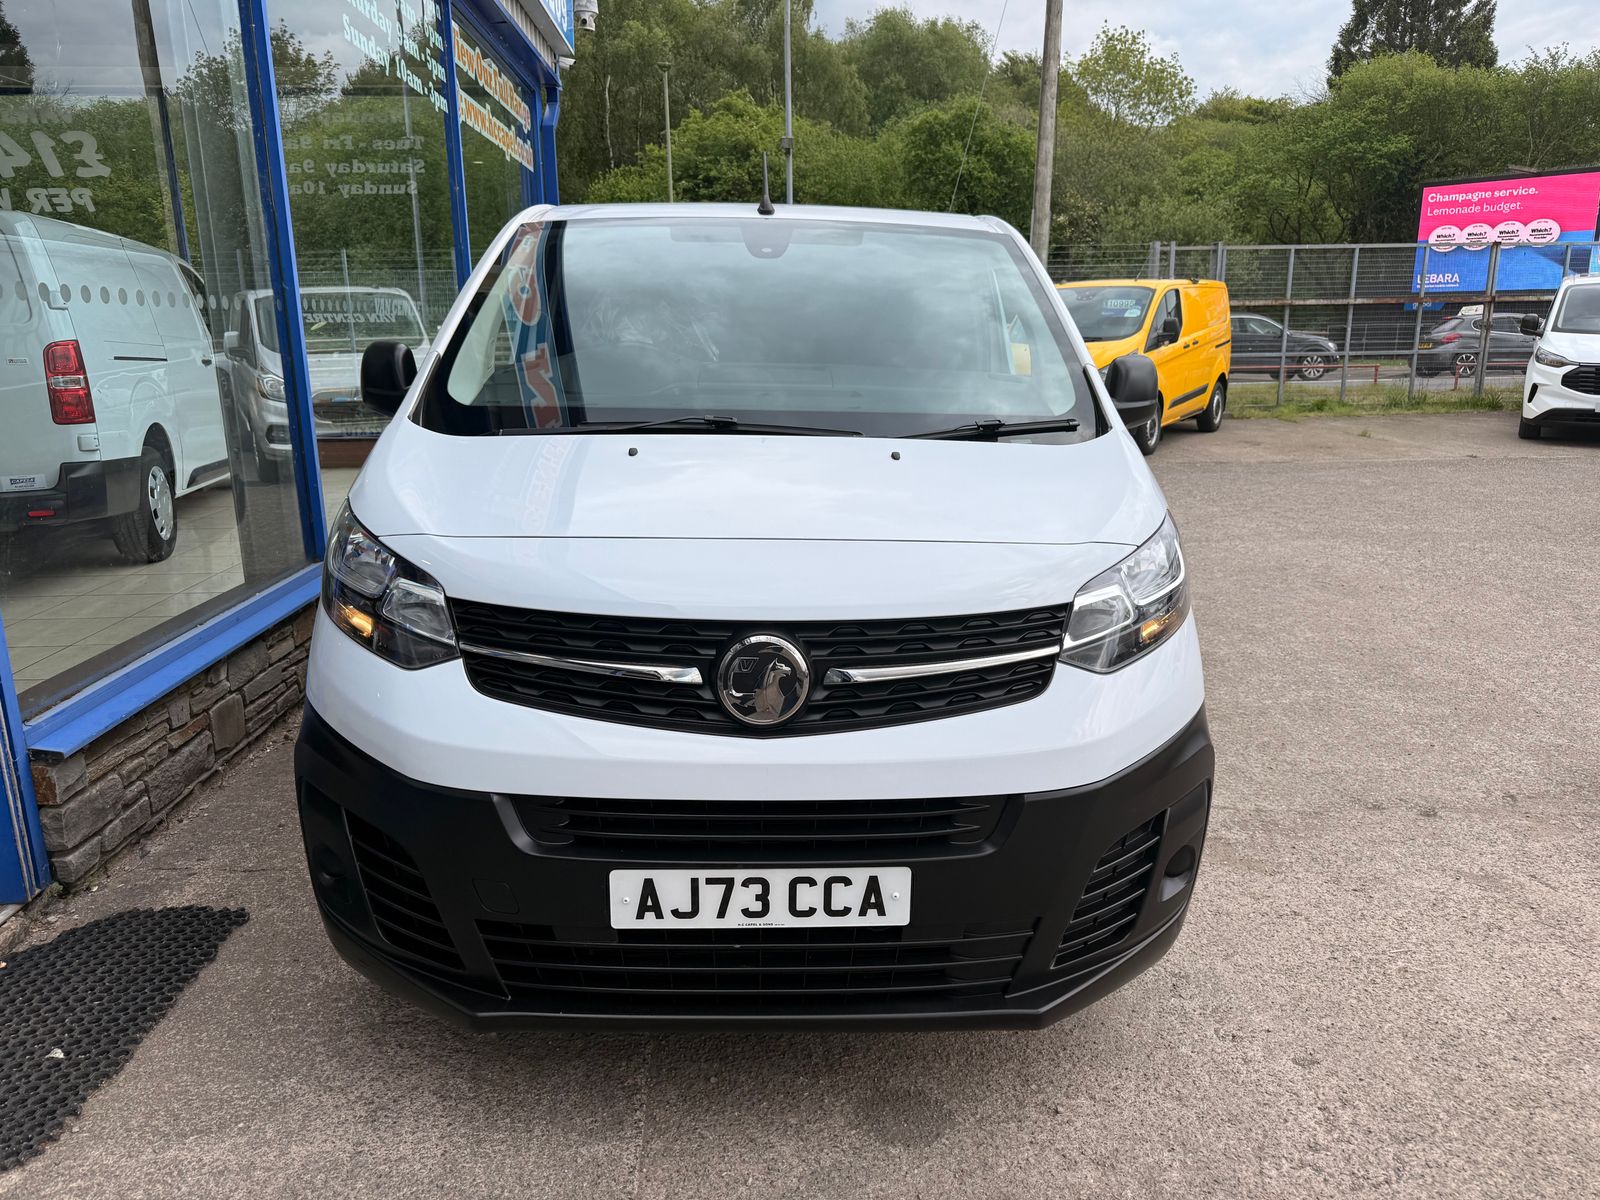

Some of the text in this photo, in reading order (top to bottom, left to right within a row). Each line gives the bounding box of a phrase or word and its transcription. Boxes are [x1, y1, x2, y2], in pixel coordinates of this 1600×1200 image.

[342, 13, 391, 77] Sunday
[395, 54, 424, 96] 10am
[428, 81, 449, 114] 3pm
[396, 21, 420, 61] 9am
[425, 46, 447, 83] 5pm
[1427, 201, 1524, 217] Lemonade budget.
[1428, 185, 1539, 203] Champagne service.
[635, 875, 887, 921] AJ73 CCA
